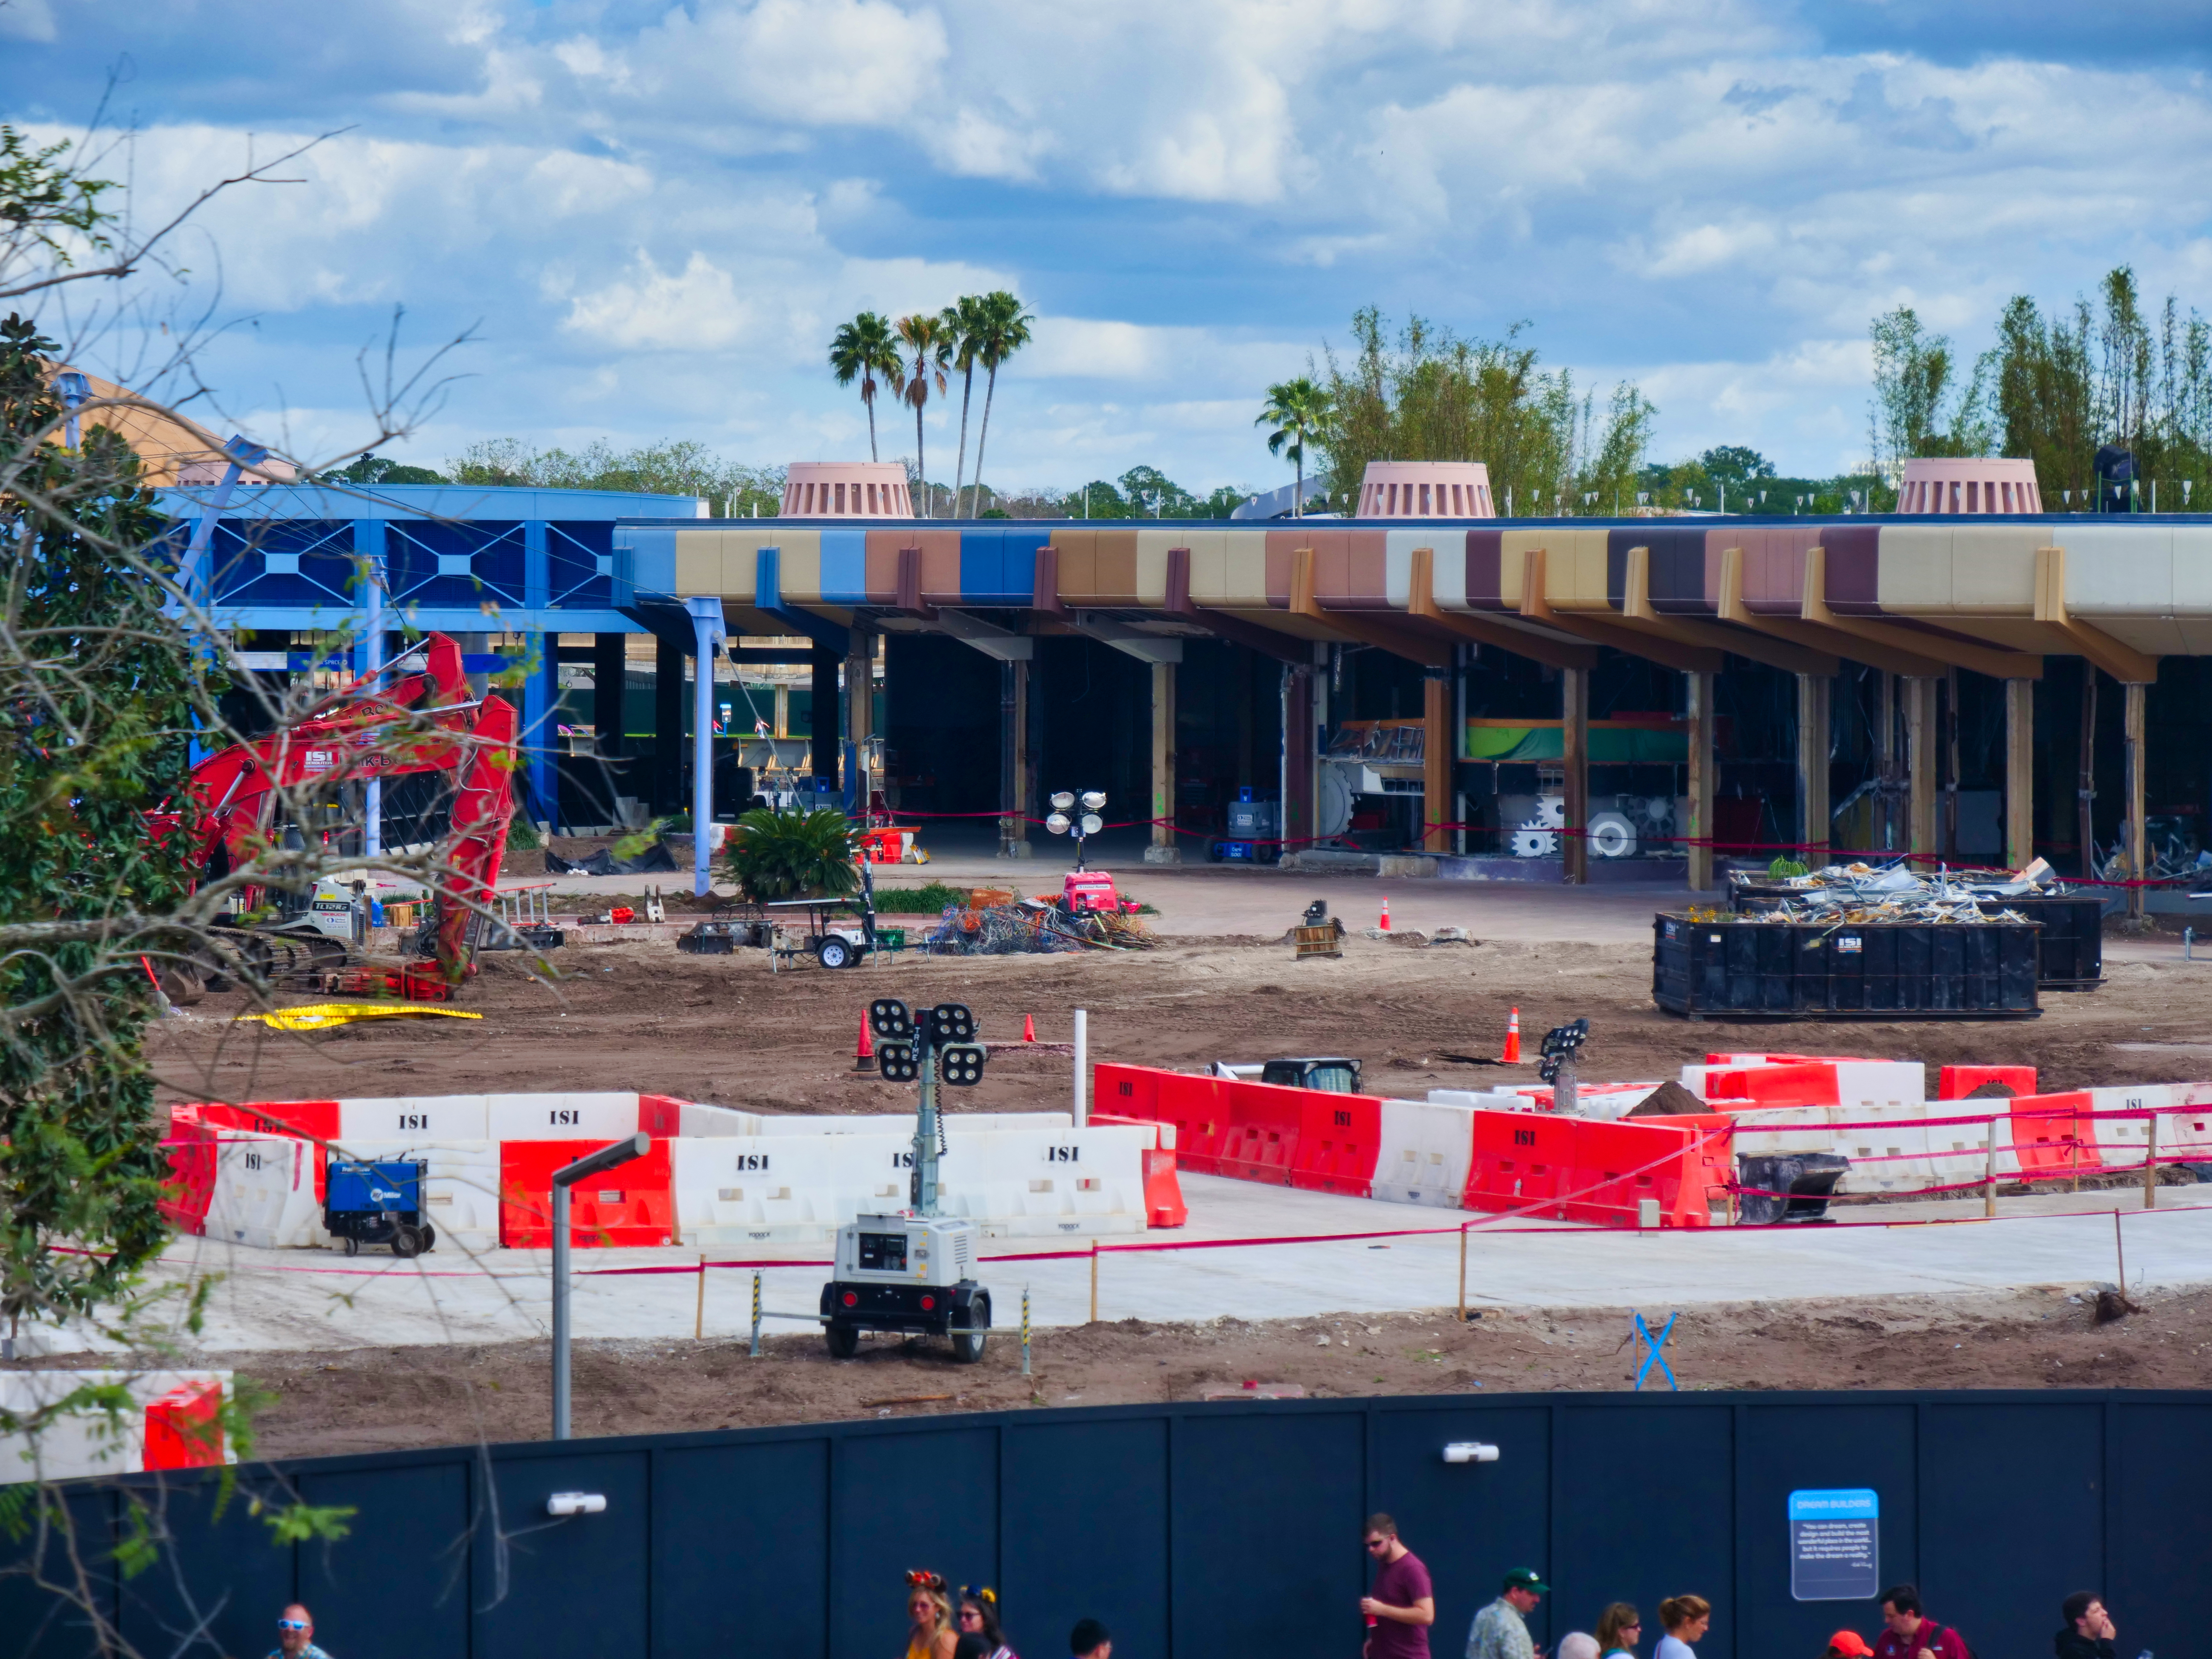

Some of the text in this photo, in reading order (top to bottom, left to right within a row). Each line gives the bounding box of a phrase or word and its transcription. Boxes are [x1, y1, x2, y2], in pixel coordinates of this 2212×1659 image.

[306, 751, 332, 762] ISI
[1839, 938, 1862, 946] ISI
[1119, 1081, 1132, 1096] ISI
[399, 1115, 428, 1129] ISI
[550, 1110, 579, 1125] ISI
[1334, 1111, 1351, 1126] ISI
[1514, 1130, 1535, 1145] ISI
[893, 1153, 913, 1168] IS
[1049, 1146, 1079, 1161] ISI
[246, 1153, 261, 1170] ISI
[737, 1155, 768, 1170] ISI
